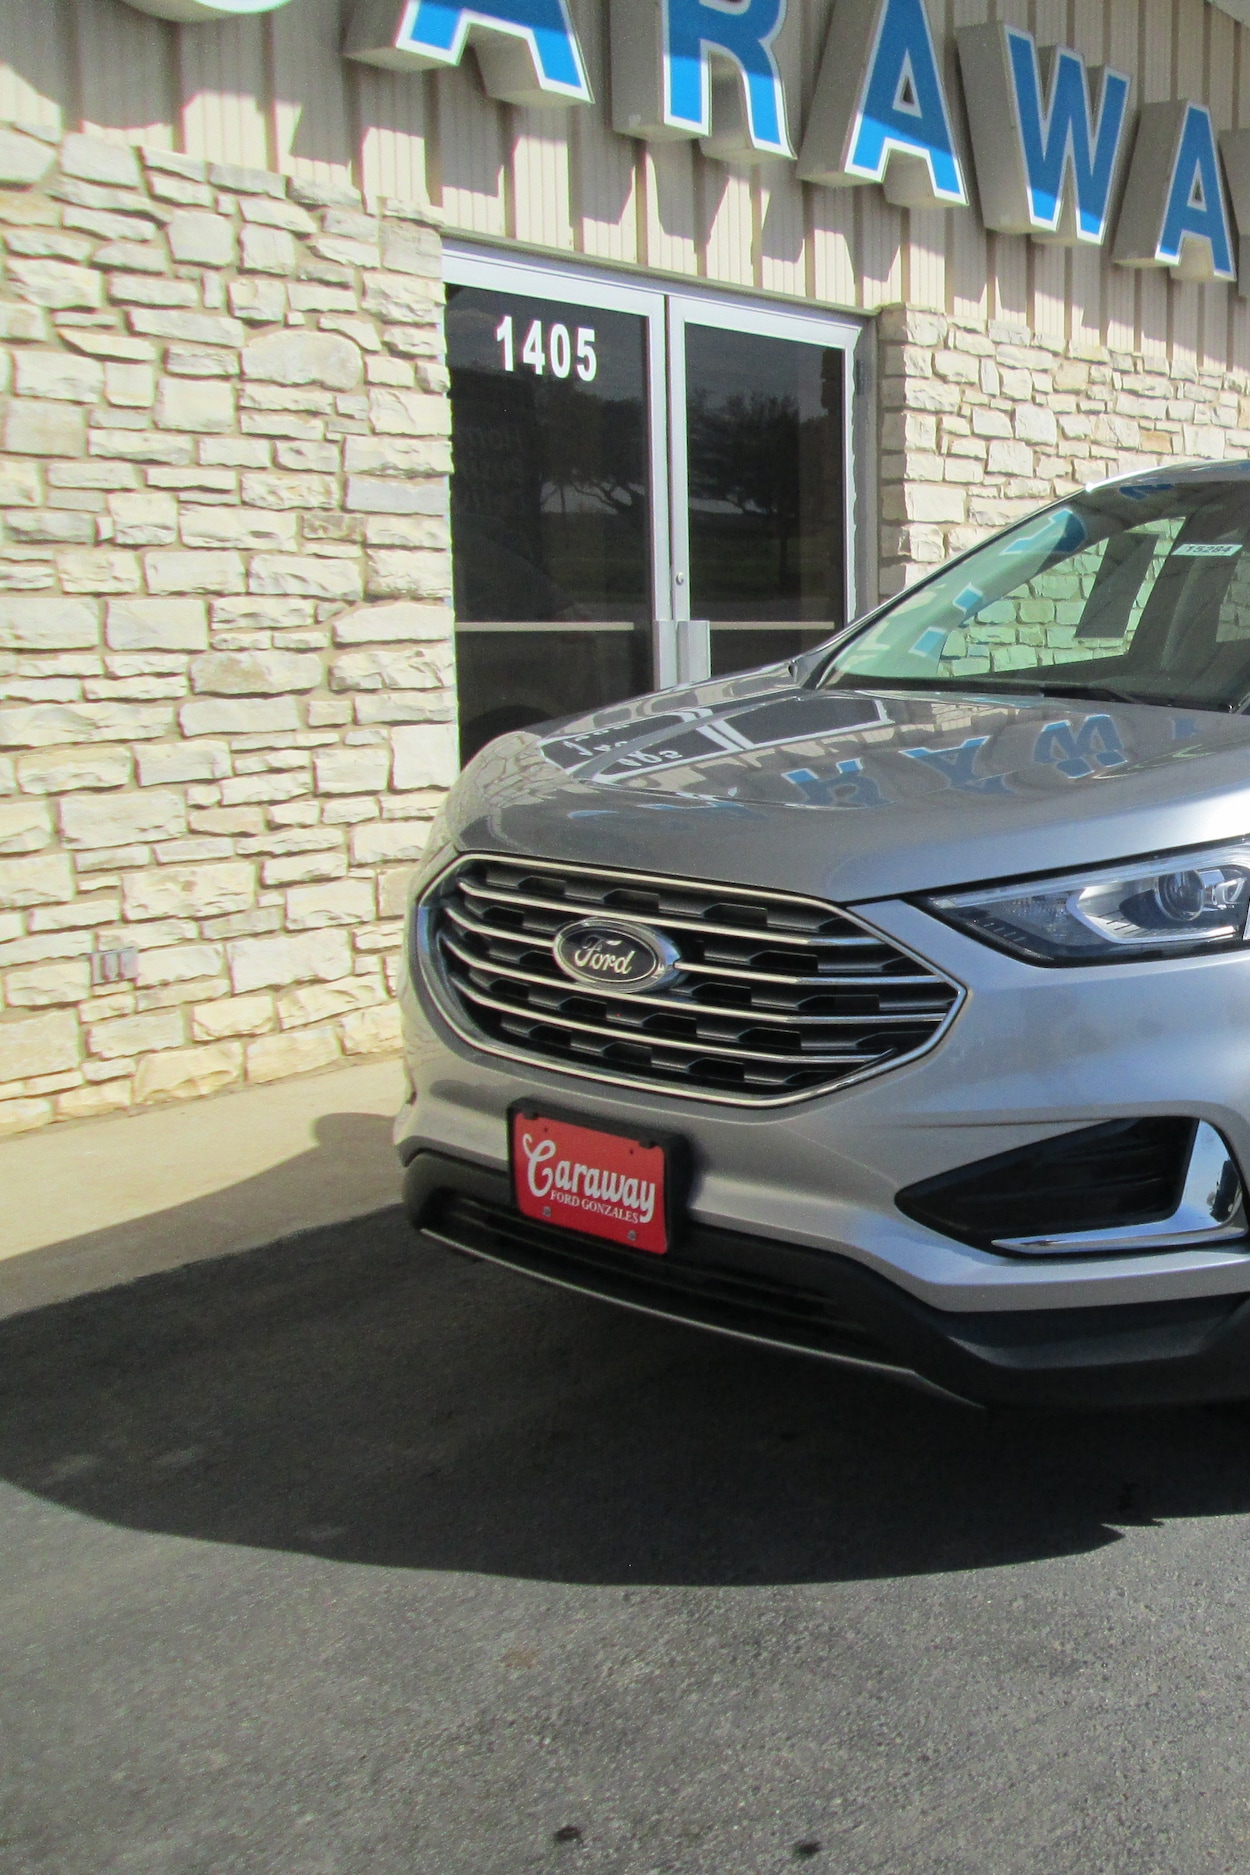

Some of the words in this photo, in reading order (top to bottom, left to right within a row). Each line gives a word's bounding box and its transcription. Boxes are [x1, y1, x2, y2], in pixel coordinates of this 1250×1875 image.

[496, 315, 597, 382] 1405
[575, 935, 636, 975] Ford
[523, 1133, 656, 1224] Caraway
[550, 1190, 580, 1207] FORD
[581, 1199, 640, 1224] GONZALES
